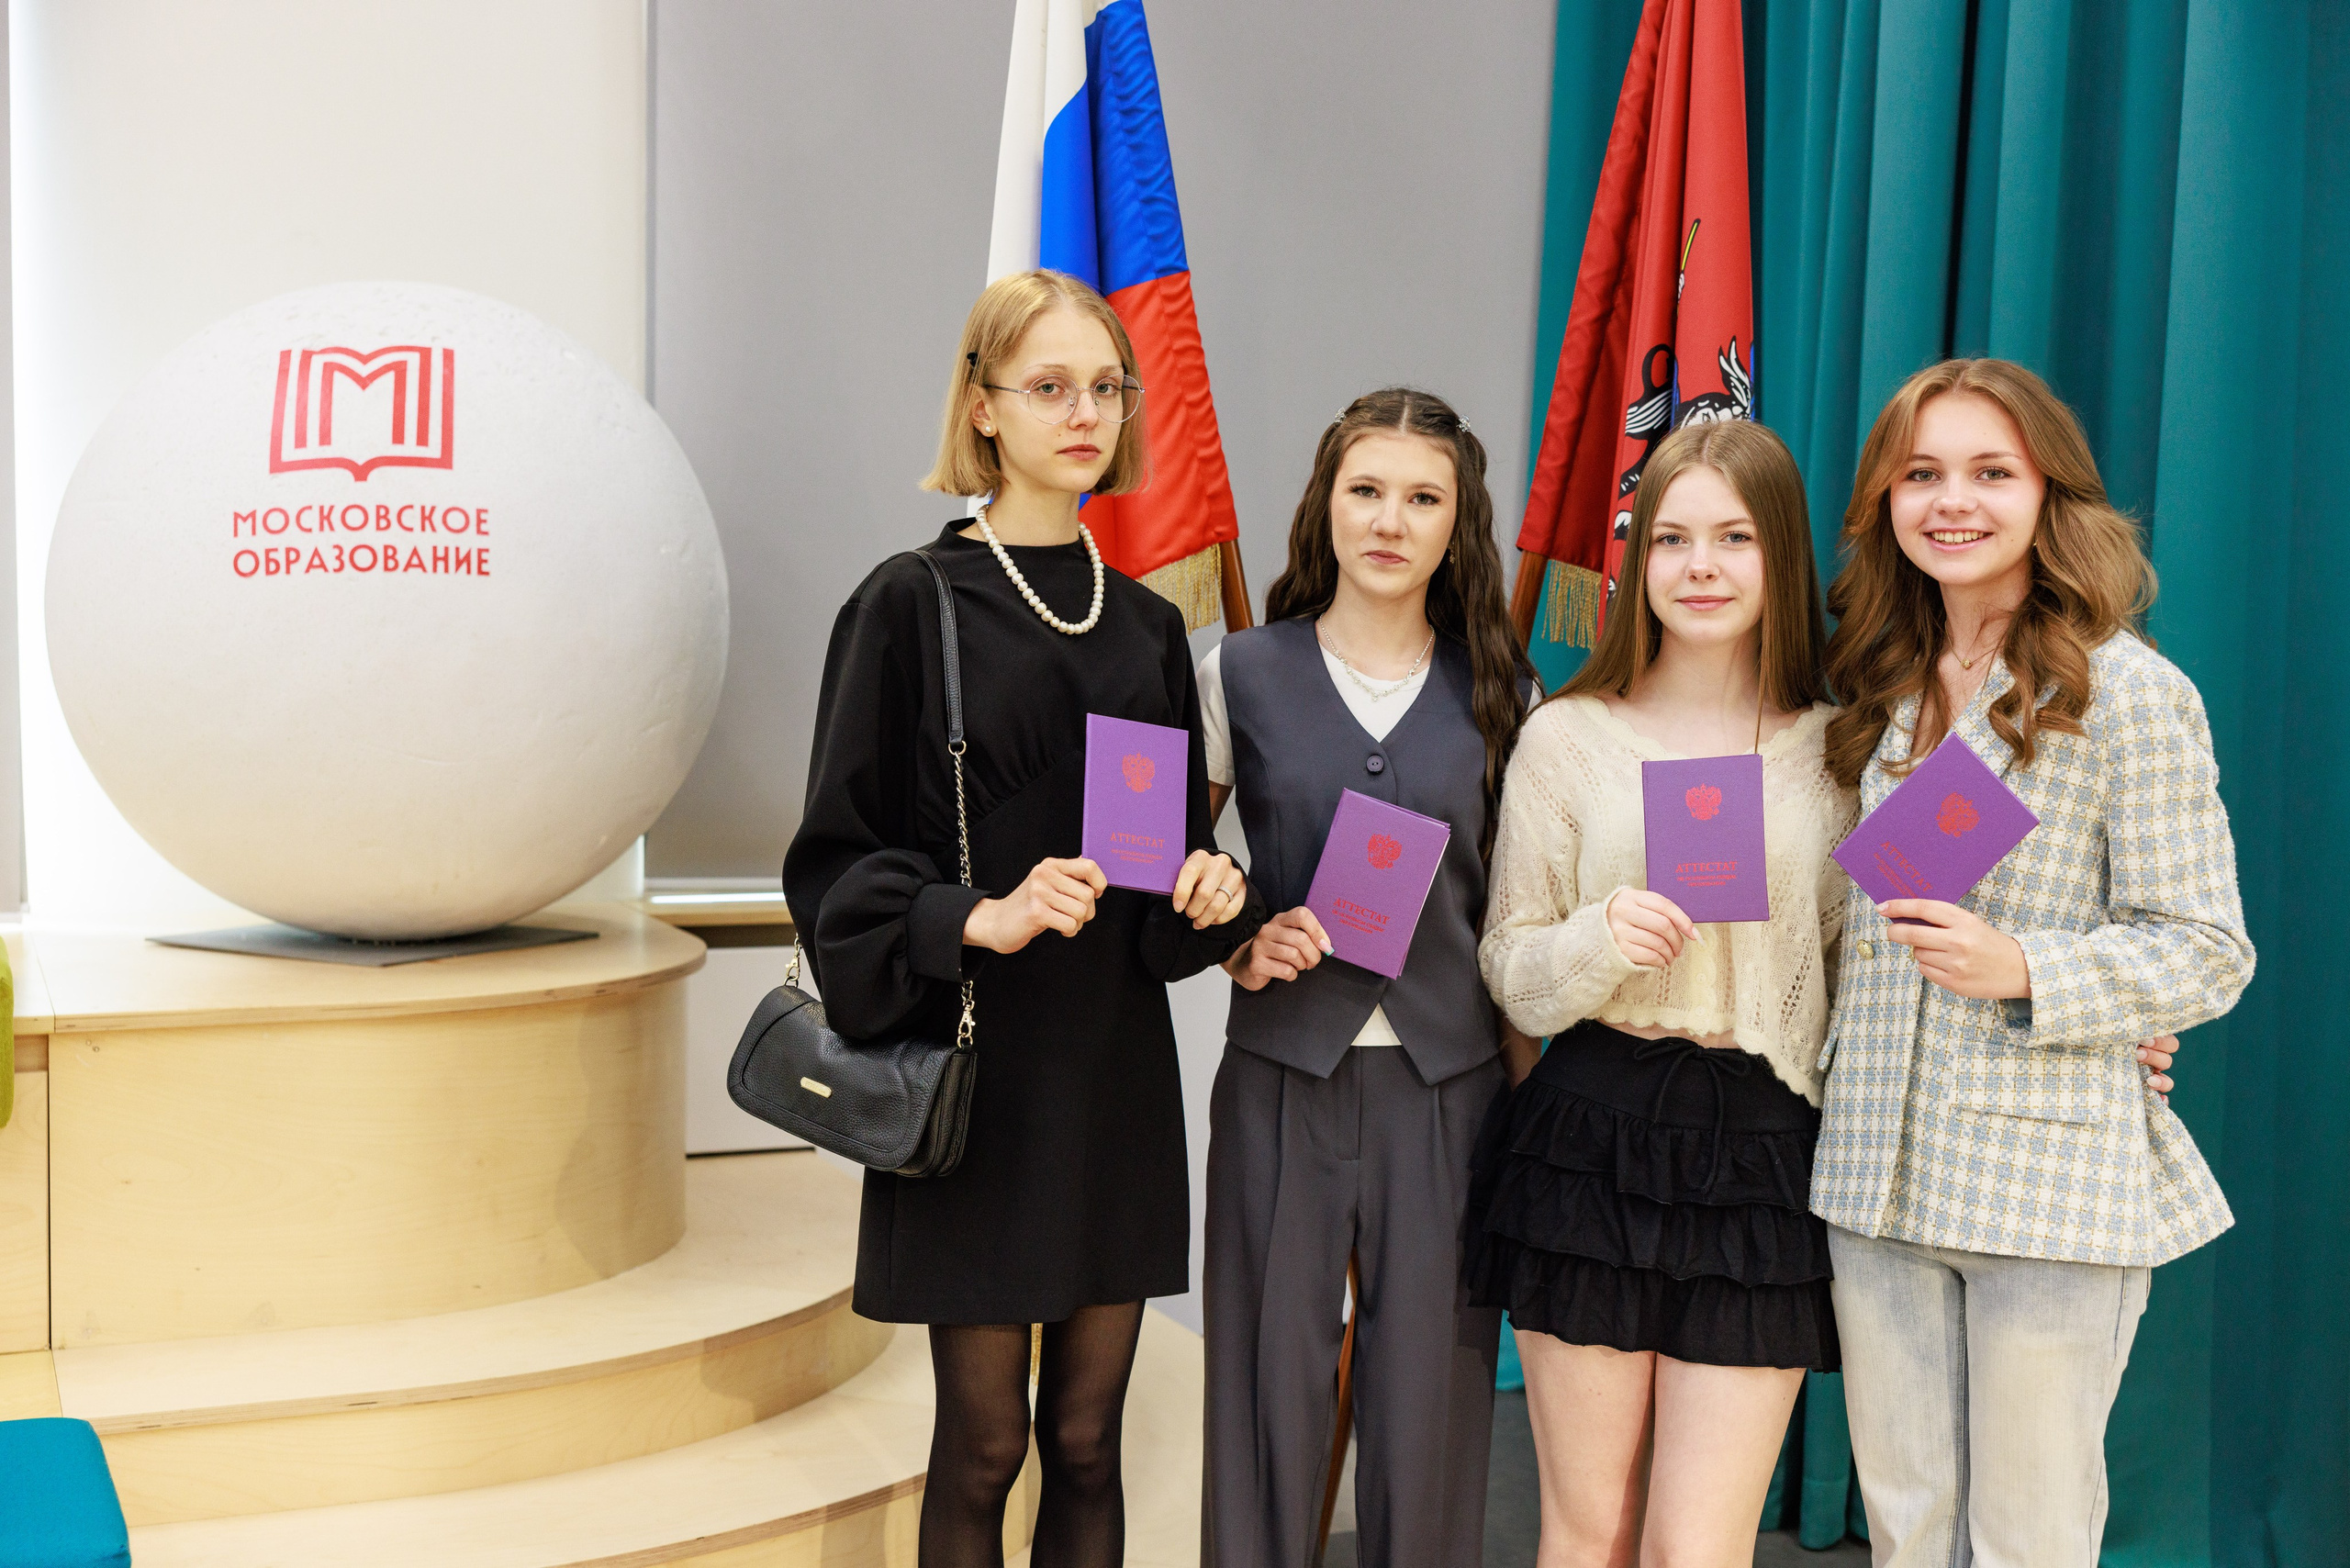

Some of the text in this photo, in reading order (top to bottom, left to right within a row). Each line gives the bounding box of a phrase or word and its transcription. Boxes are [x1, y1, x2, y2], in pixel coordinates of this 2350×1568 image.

[232, 504, 489, 538] МОСКОВСКОЕ
[232, 544, 490, 578] ОБРАЗОВАНИЕ
[1110, 832, 1165, 849] АТТЕСТАТ
[1675, 860, 1738, 874] АТТЕСТАТ
[1880, 841, 1933, 892] АТТЕСТАТ
[1333, 897, 1390, 925] АТТЕСТАТ
